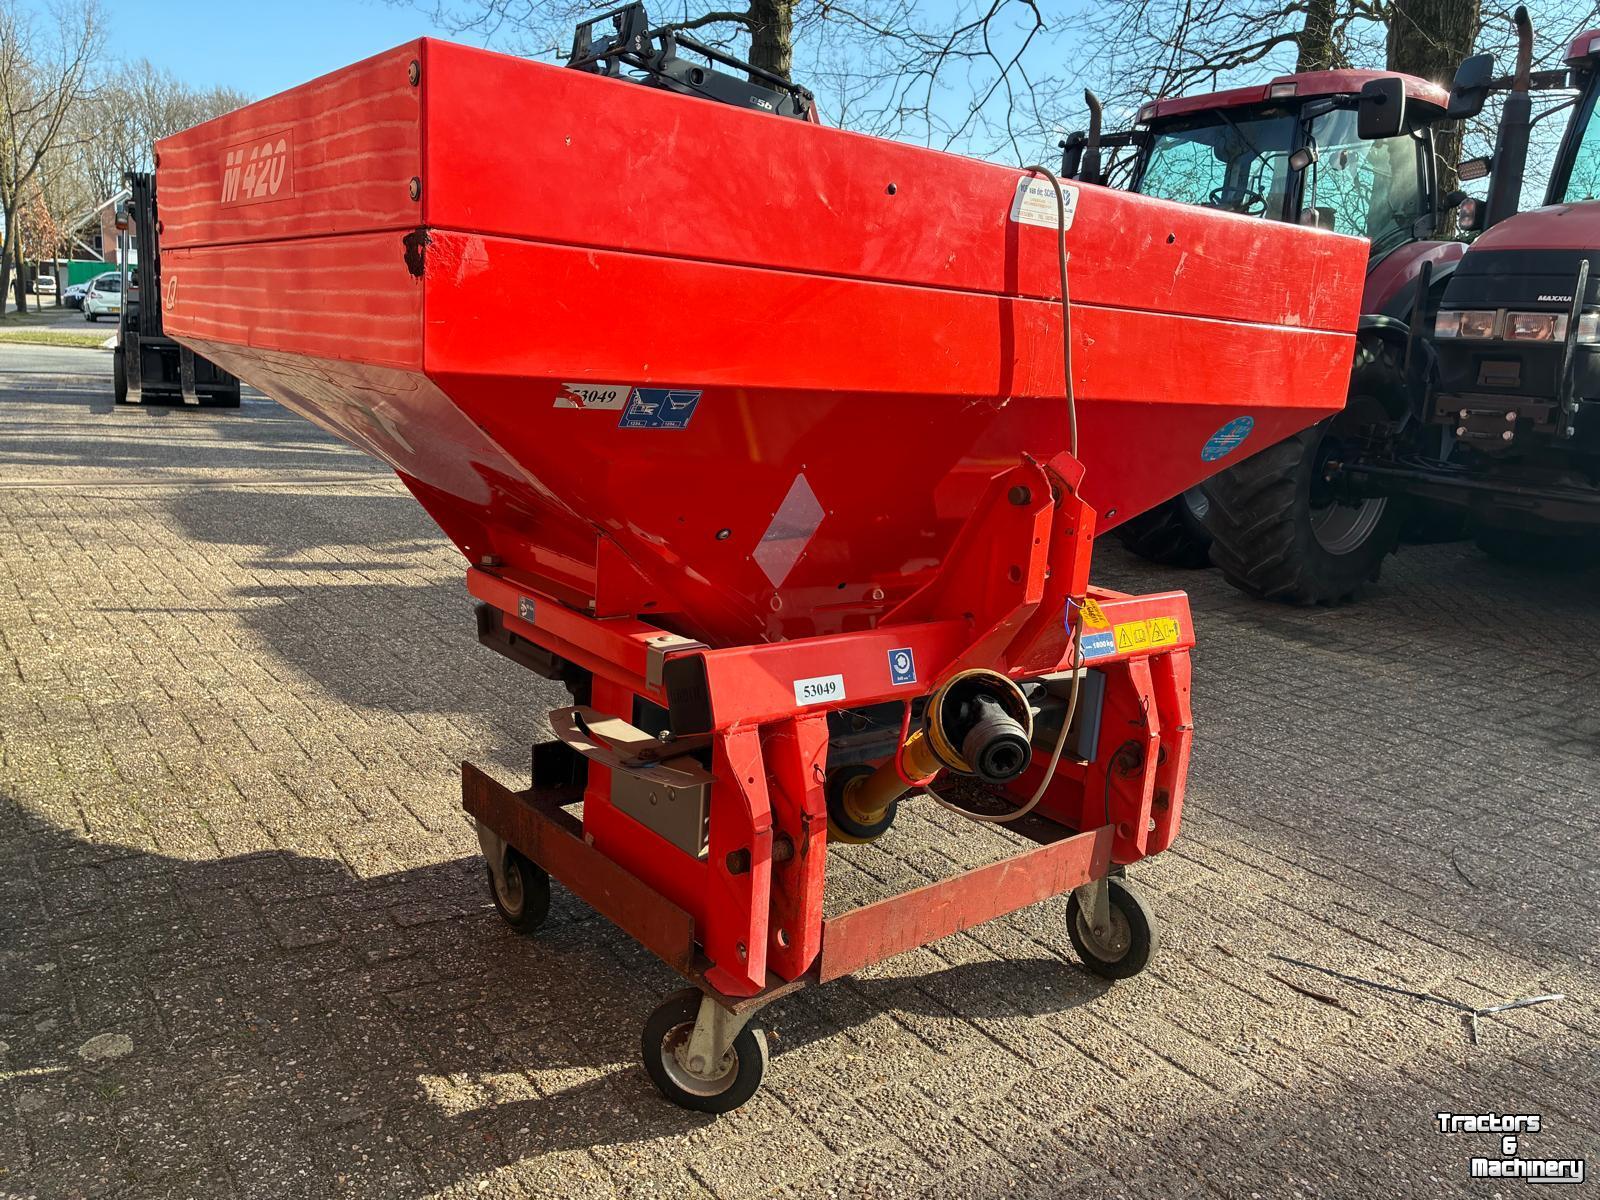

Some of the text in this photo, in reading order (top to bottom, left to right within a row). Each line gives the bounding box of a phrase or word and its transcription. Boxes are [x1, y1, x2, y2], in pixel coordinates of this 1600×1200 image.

[242, 138, 287, 200] 420
[572, 389, 617, 403] 3049
[803, 681, 836, 698] 53049
